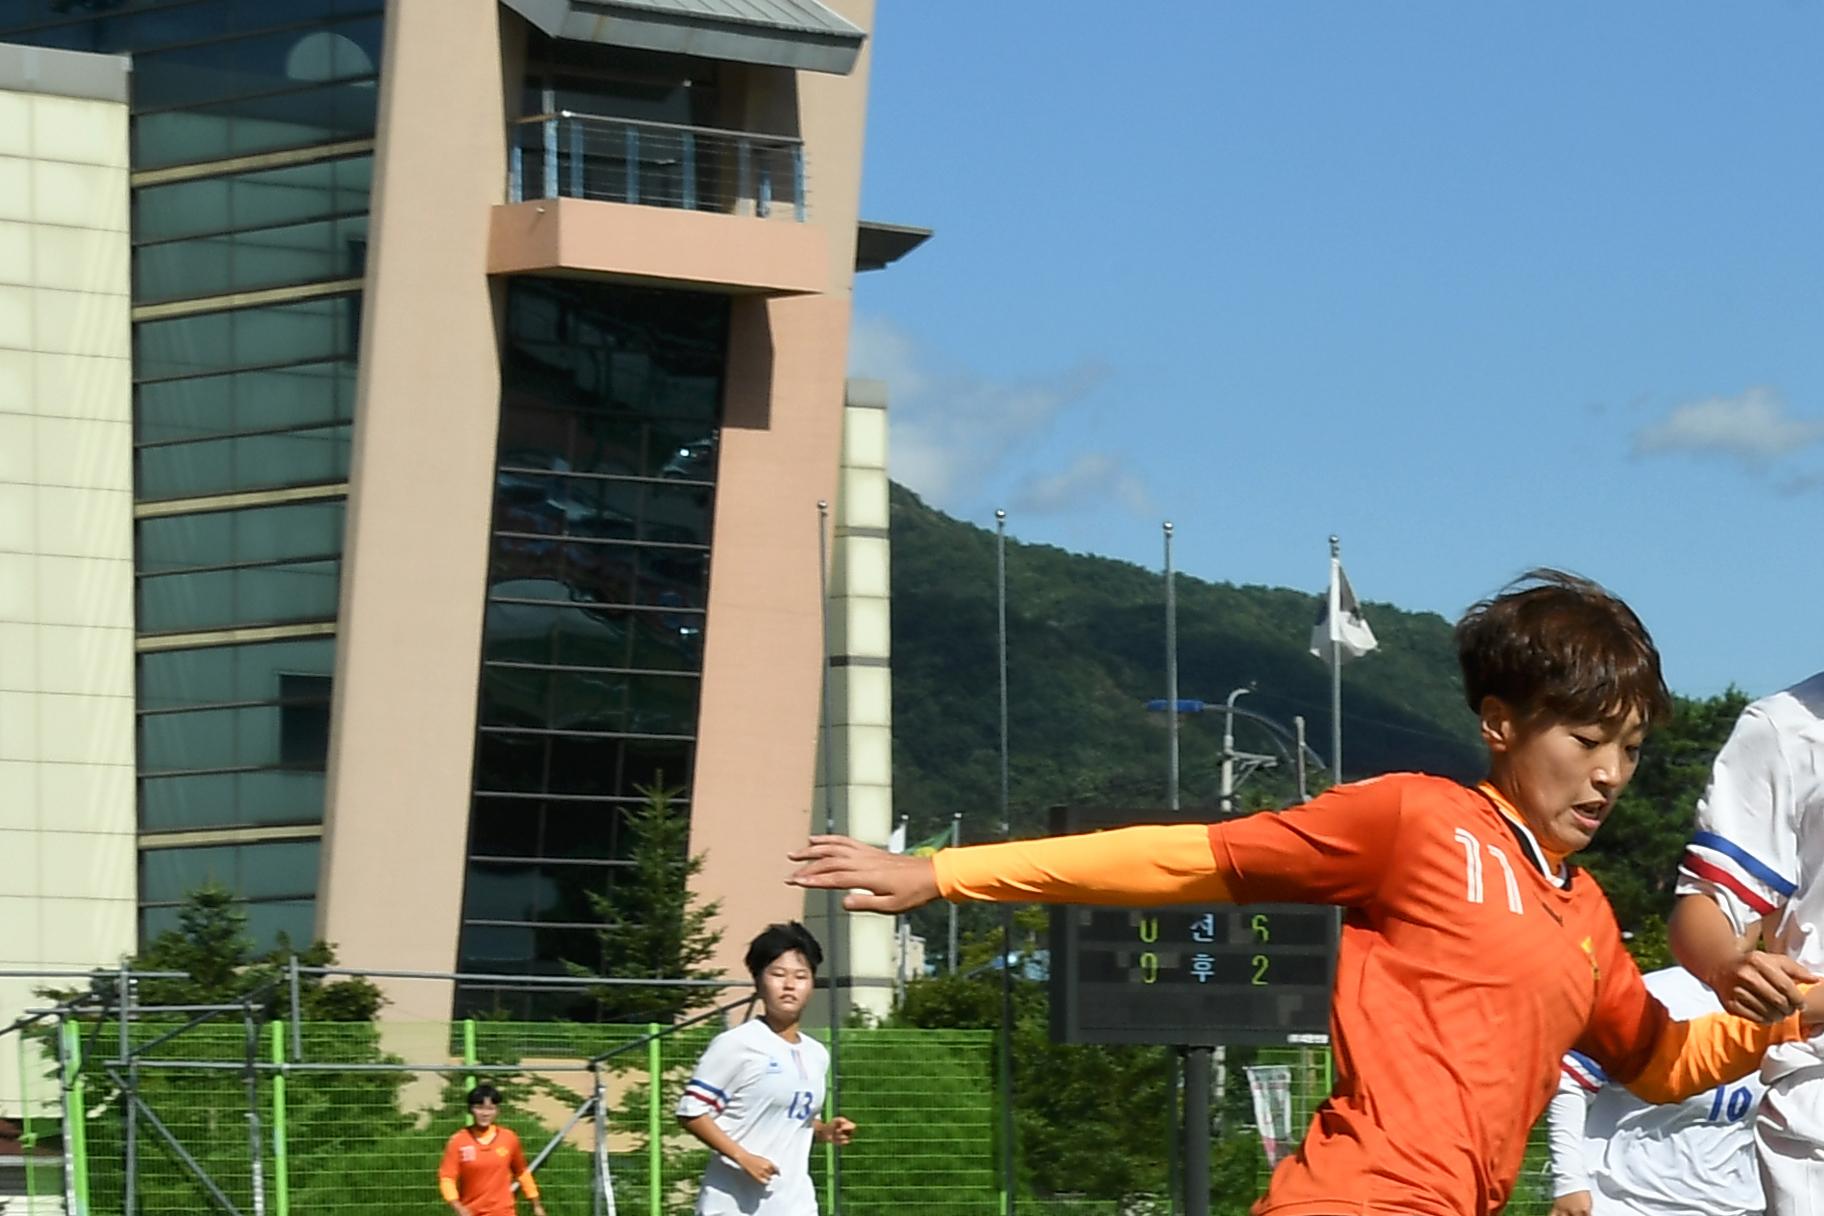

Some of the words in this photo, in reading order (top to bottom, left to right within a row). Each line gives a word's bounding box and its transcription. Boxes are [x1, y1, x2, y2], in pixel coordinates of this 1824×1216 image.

[1454, 827, 1524, 915] 11
[1190, 953, 1215, 983] 후
[1251, 955, 1269, 986] 2
[788, 1091, 814, 1120] 13
[1708, 1084, 1753, 1122] 10
